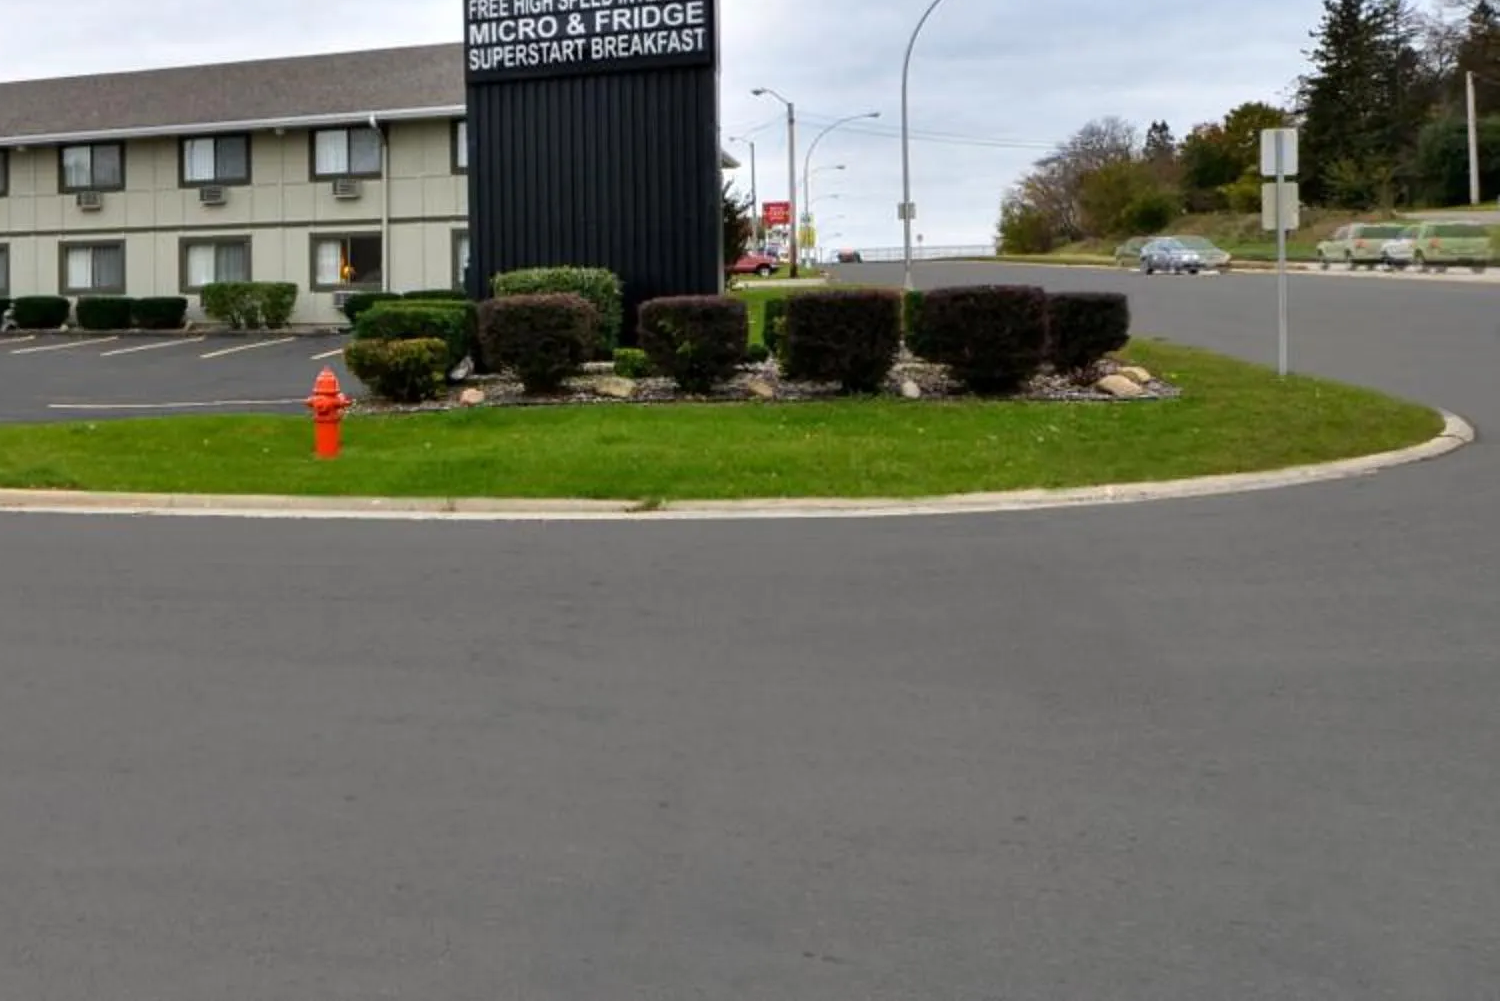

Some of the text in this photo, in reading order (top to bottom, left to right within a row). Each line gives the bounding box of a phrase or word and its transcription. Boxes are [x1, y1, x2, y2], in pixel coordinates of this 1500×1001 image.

[469, 0, 704, 45] MICRO & FRIDGE
[469, 28, 706, 72] SUPERSTART BREAKFAST
